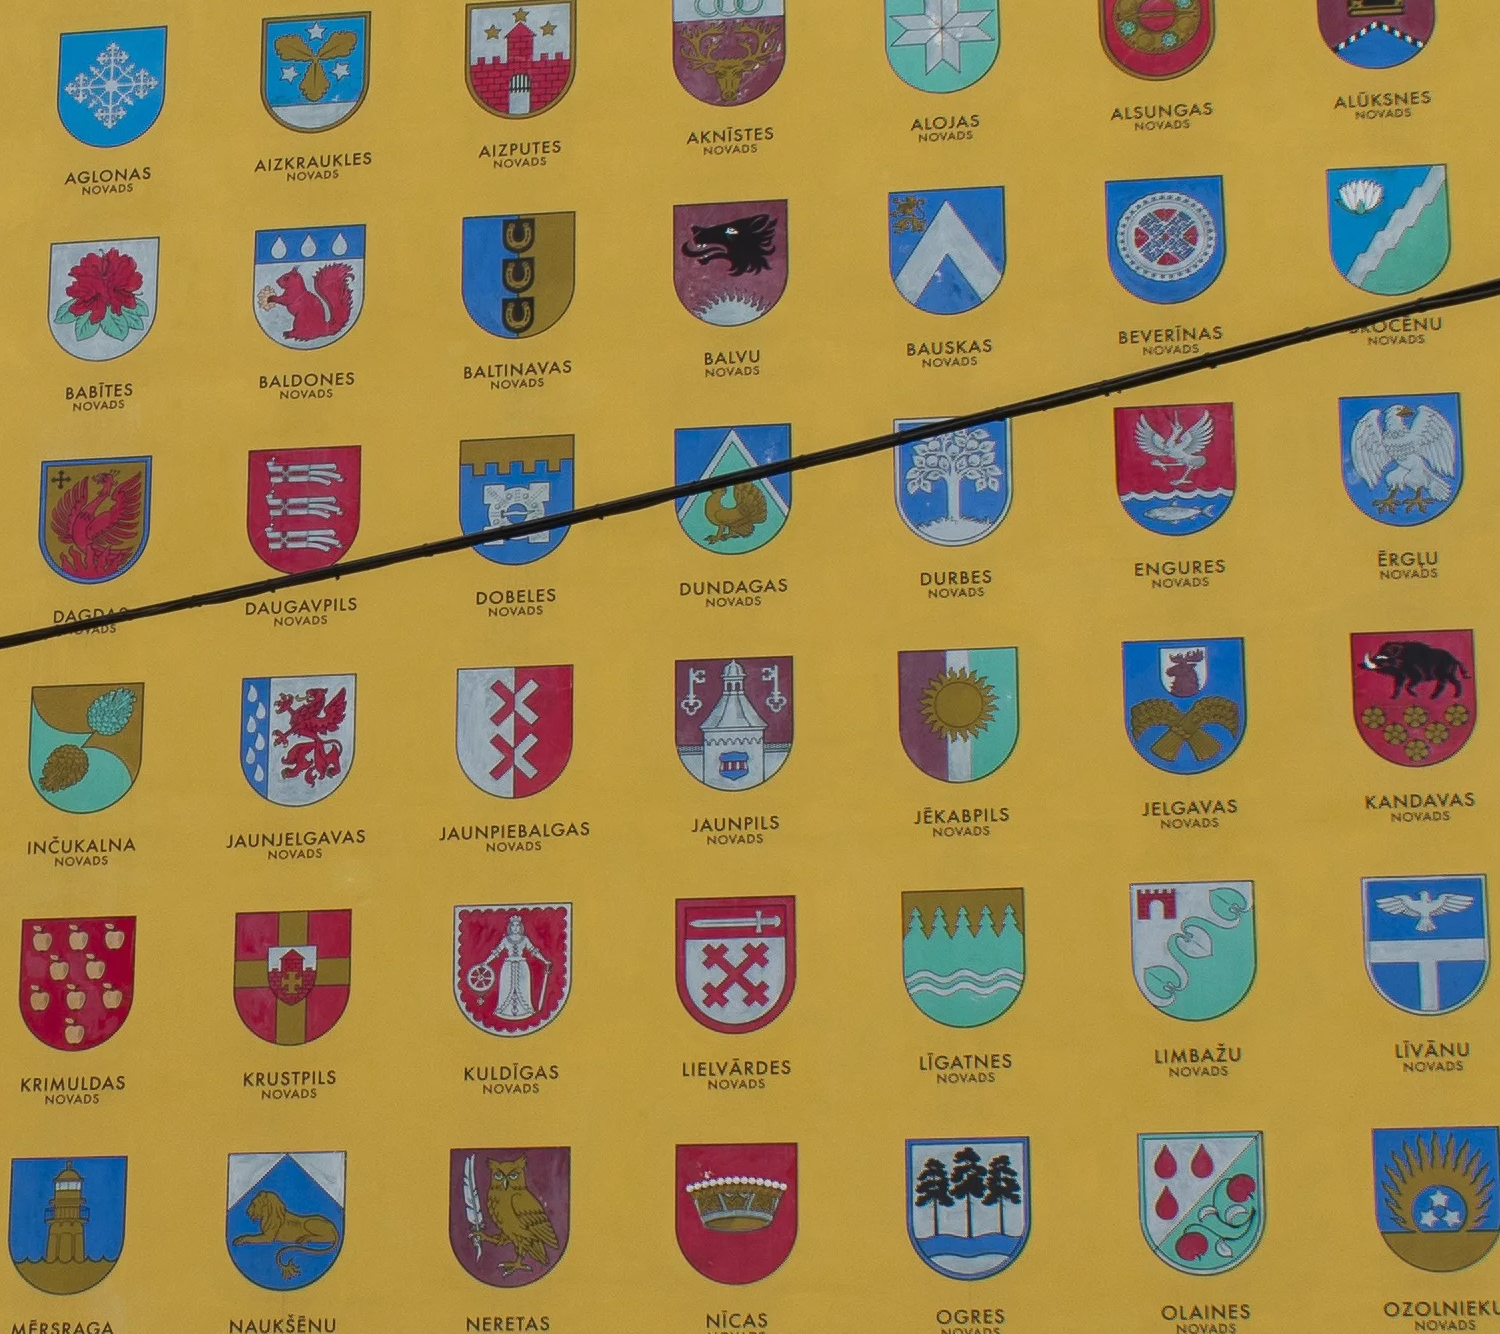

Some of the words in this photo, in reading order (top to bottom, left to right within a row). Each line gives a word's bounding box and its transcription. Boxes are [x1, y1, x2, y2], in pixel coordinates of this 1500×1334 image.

[1333, 90, 1432, 110] ALŪKSNES
[1110, 101, 1214, 121] ALSUNGAS
[910, 114, 980, 132] ALOJAS
[686, 126, 774, 145] AKNĪSTES
[478, 140, 562, 159] AIZPUTES
[254, 151, 372, 173] AIZKRAUKLES
[64, 166, 152, 186] AGLONAS
[1118, 325, 1223, 345] BEVERĪNAS
[906, 338, 993, 357] BAUSKAS
[704, 349, 761, 366] BALVU
[463, 359, 572, 380] BALTINAVAS
[259, 371, 355, 389] BALDONES
[65, 381, 133, 401] BABĪTES
[1134, 559, 1226, 577] ENGURES
[1377, 549, 1438, 571] ĒRGĻU
[679, 578, 788, 597] DUNDAGAS
[920, 569, 992, 587] DURBES
[245, 597, 357, 616] DAUGAVPILS
[475, 588, 556, 606] DOBELES
[1141, 798, 1238, 817] JELGAVAS
[1364, 791, 1476, 810] KANDAVAS
[690, 815, 780, 833] JAUNPILS
[913, 806, 1010, 825] JĒKABPILS
[225, 829, 366, 849] JAUNJELGAVAS
[438, 821, 590, 842] JAUNPIEBALGAS
[27, 835, 136, 855] INČUKALNA
[1154, 1042, 1242, 1065] LIMBAŽU
[1394, 1039, 1470, 1059] LĪVĀNU
[682, 1057, 792, 1077] LIELVĀRDES
[919, 1052, 1012, 1071] LĪGATNES
[243, 1069, 337, 1087] KRUSTPILS
[463, 1062, 560, 1082] KULDĪGAS
[20, 1075, 126, 1093] KRIMULDAS
[706, 1309, 768, 1329] NĪCAS
[936, 1308, 1006, 1325] OGRES
[1160, 1303, 1251, 1321] OLAINES
[229, 1313, 336, 1334] NAUKŠĒNU
[466, 1315, 550, 1333] NERETAS
